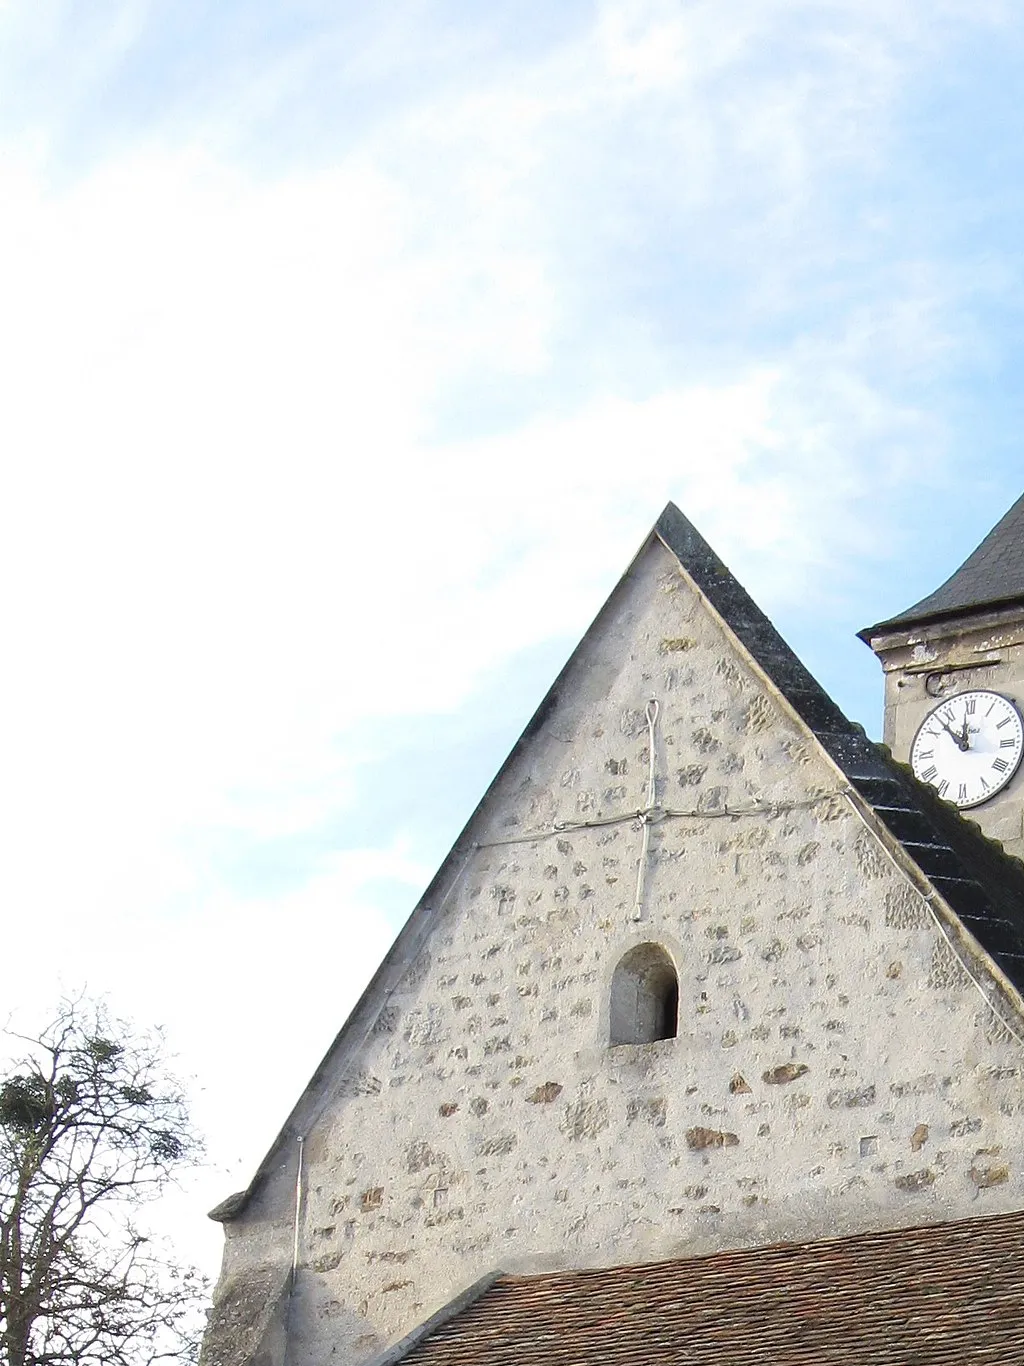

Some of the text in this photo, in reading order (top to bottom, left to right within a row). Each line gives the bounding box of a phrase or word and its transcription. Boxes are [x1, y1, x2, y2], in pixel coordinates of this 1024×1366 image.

[965, 699, 976, 715] XII
[943, 707, 956, 722] XI
[996, 716, 1011, 730] II
[926, 727, 941, 739] X
[1000, 738, 1015, 748] III
